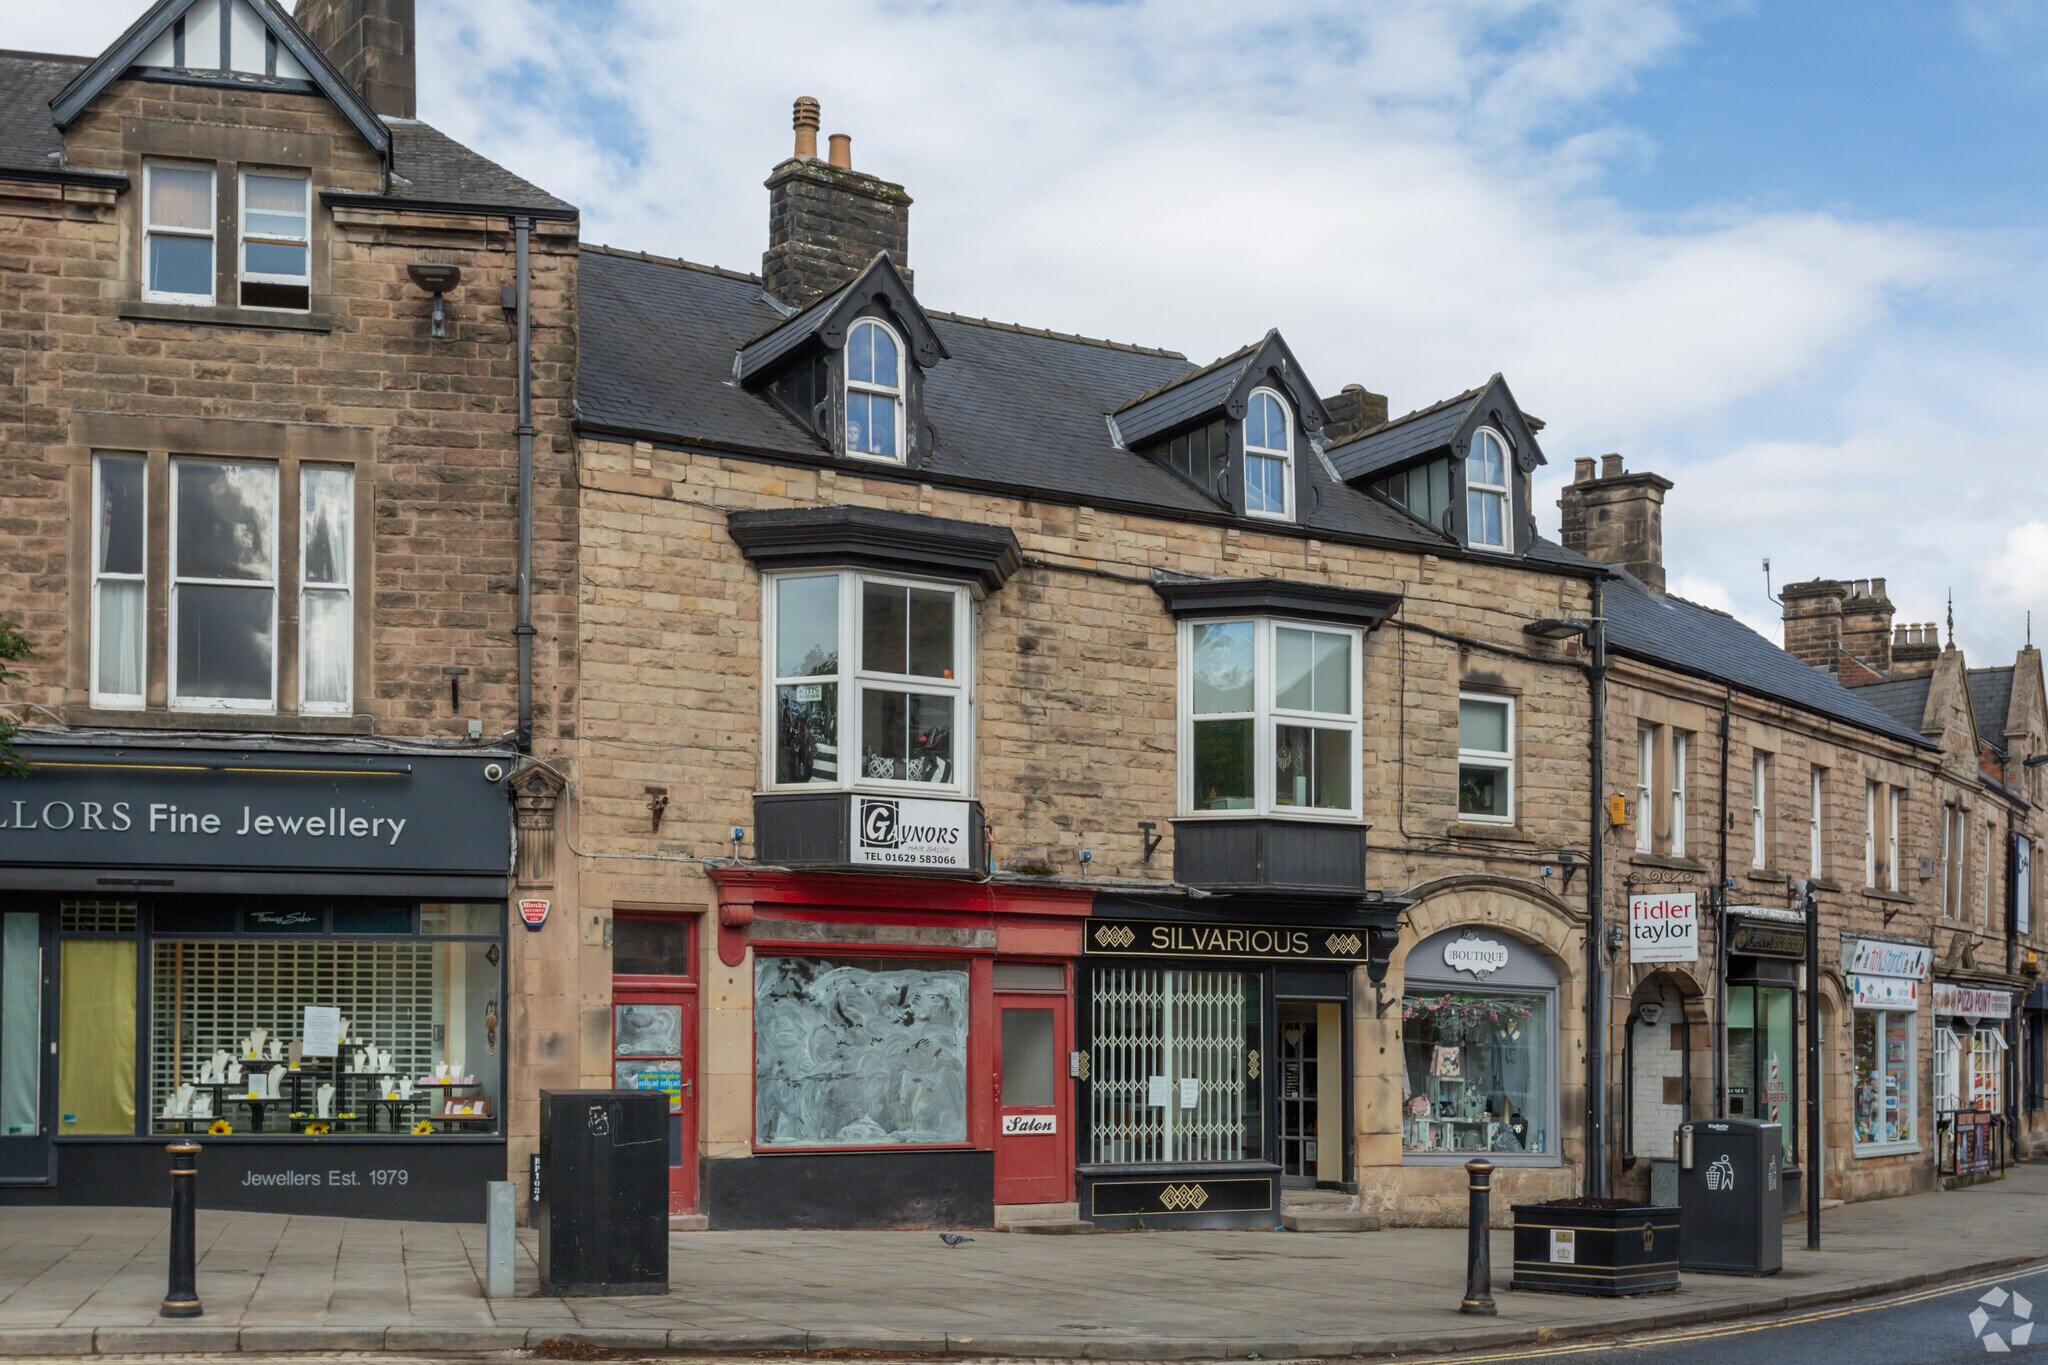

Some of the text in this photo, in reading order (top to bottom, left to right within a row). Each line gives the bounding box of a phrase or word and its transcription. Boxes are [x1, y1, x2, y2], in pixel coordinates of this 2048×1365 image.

[0, 800, 407, 846] LORS Fine Jewellery
[865, 852, 956, 865] TEL 01629 583066
[606, 881, 656, 894] JUBILEE
[1633, 900, 1692, 920] fidler
[1151, 926, 1309, 954] SILVARIOUS
[1633, 920, 1692, 944] taylor
[1452, 950, 1505, 963] BOUTIQUE
[1957, 989, 1974, 1012] PIZZA
[1006, 1117, 1053, 1132] Salon
[241, 1169, 409, 1186] Jewellers Est. 1979
